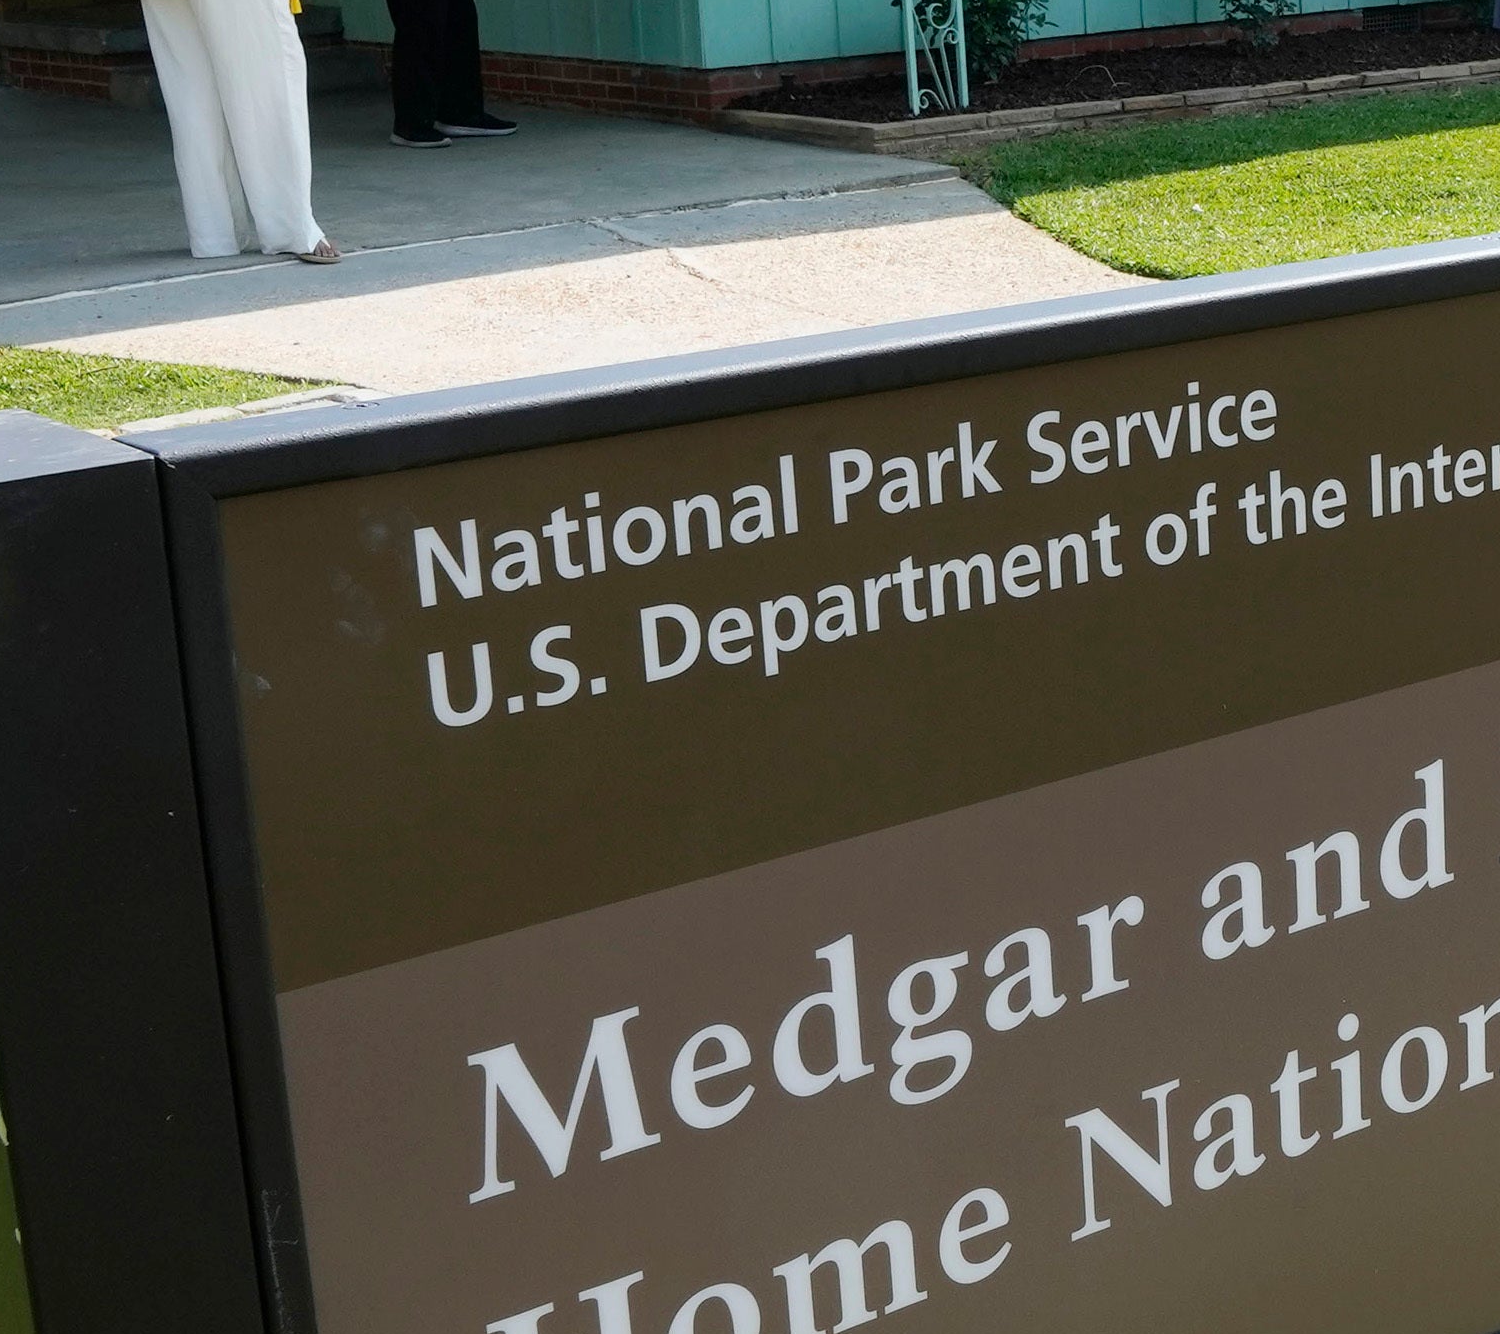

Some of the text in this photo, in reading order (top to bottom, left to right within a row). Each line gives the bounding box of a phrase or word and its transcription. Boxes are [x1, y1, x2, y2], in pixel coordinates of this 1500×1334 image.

[412, 381, 1278, 609] National Park Service
[426, 624, 607, 728] U.S.
[640, 512, 1124, 684] Department
[1145, 481, 1218, 567] of
[1238, 469, 1348, 546] the
[466, 895, 1146, 1205] Medgar
[1201, 757, 1455, 961] and
